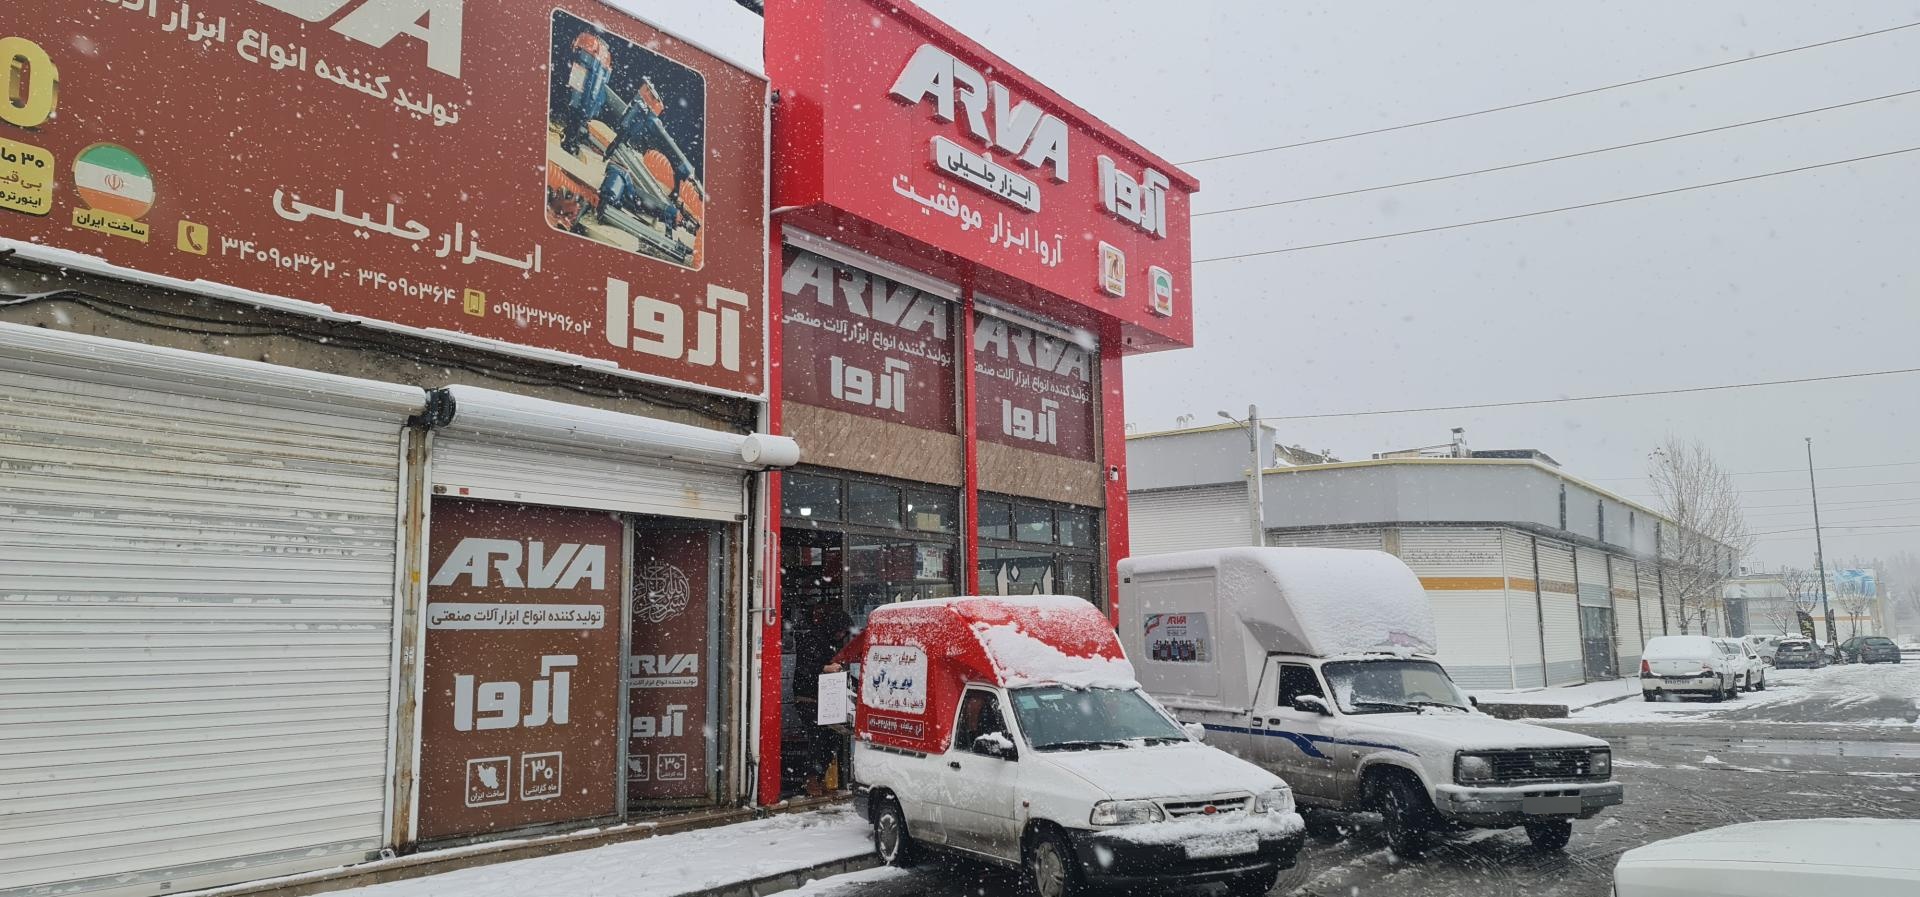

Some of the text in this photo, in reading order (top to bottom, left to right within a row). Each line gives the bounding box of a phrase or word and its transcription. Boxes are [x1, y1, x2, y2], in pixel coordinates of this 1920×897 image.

[161, 3, 226, 48] ابزار
[236, 28, 307, 71] انواع
[315, 59, 391, 99] کننده
[393, 88, 459, 127] تولید
[888, 43, 1069, 183] ARVA
[947, 152, 1031, 205] ابزار جلیلی
[1097, 155, 1170, 239] آروا
[892, 174, 982, 231] موفقیت
[76, 213, 145, 236] ساخت ایران
[273, 189, 542, 279] ابزار جلیلی
[990, 212, 1029, 255] ابزار
[1034, 229, 1063, 267] آروا
[221, 236, 336, 279] ۳۴۰۹۰۳۶۲
[358, 268, 456, 305] ۳۴۰۹۰۳۶۴
[782, 251, 947, 340] ARVA
[606, 277, 748, 372] آروا
[781, 308, 822, 328] صنعتی
[823, 318, 848, 336] آلات
[848, 322, 870, 345] ابزار
[871, 331, 896, 351] انواع
[974, 316, 1090, 383] ARVA
[830, 355, 910, 413] آروا
[996, 367, 1014, 382] آلات
[1014, 370, 1030, 388] ابزار
[1031, 376, 1049, 393] انواع
[1002, 397, 1060, 446] آروا
[428, 537, 606, 590] ARVA
[431, 607, 601, 625] تولید کننده انواع ابزار آلات صنعتی
[630, 653, 699, 675] RVA
[454, 655, 578, 731] آروا
[531, 758, 554, 782] ۳۰
